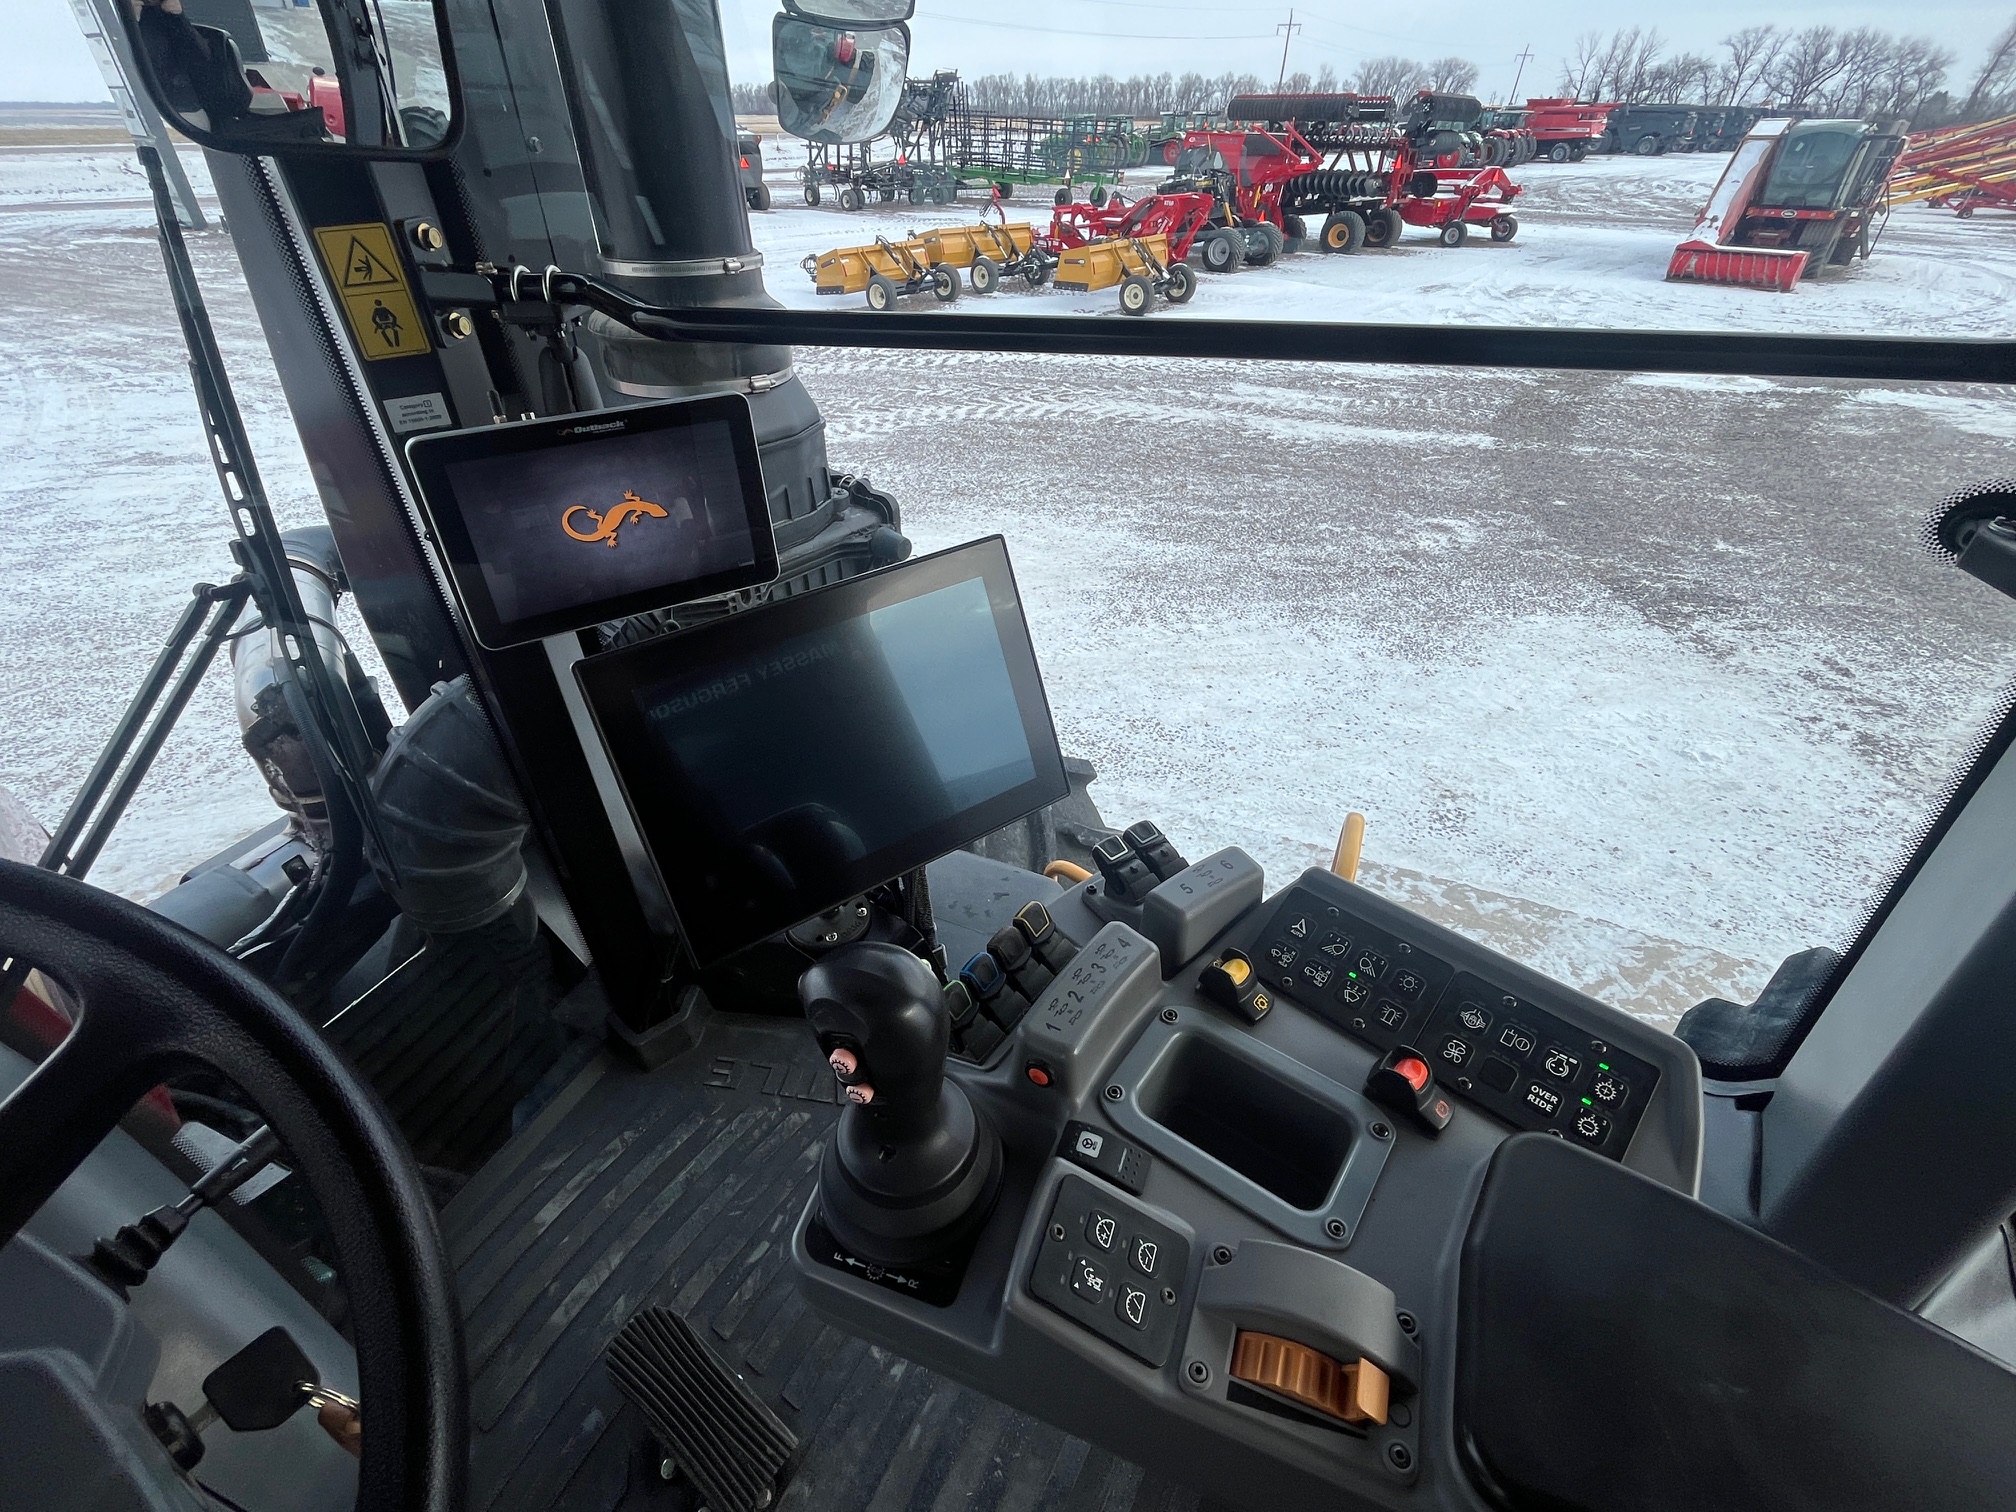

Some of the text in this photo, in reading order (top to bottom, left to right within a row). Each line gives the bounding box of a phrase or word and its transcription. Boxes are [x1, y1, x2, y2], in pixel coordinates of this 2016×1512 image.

[574, 421, 625, 433] Outback
[1180, 860, 1234, 894] 5 6
[1046, 937, 1132, 1032] 1 2 3 4
[1527, 1093, 1553, 1113] RIDE
[1531, 1085, 1558, 1105] OVER
[833, 1252, 843, 1262] F
[907, 1279, 919, 1289] R
